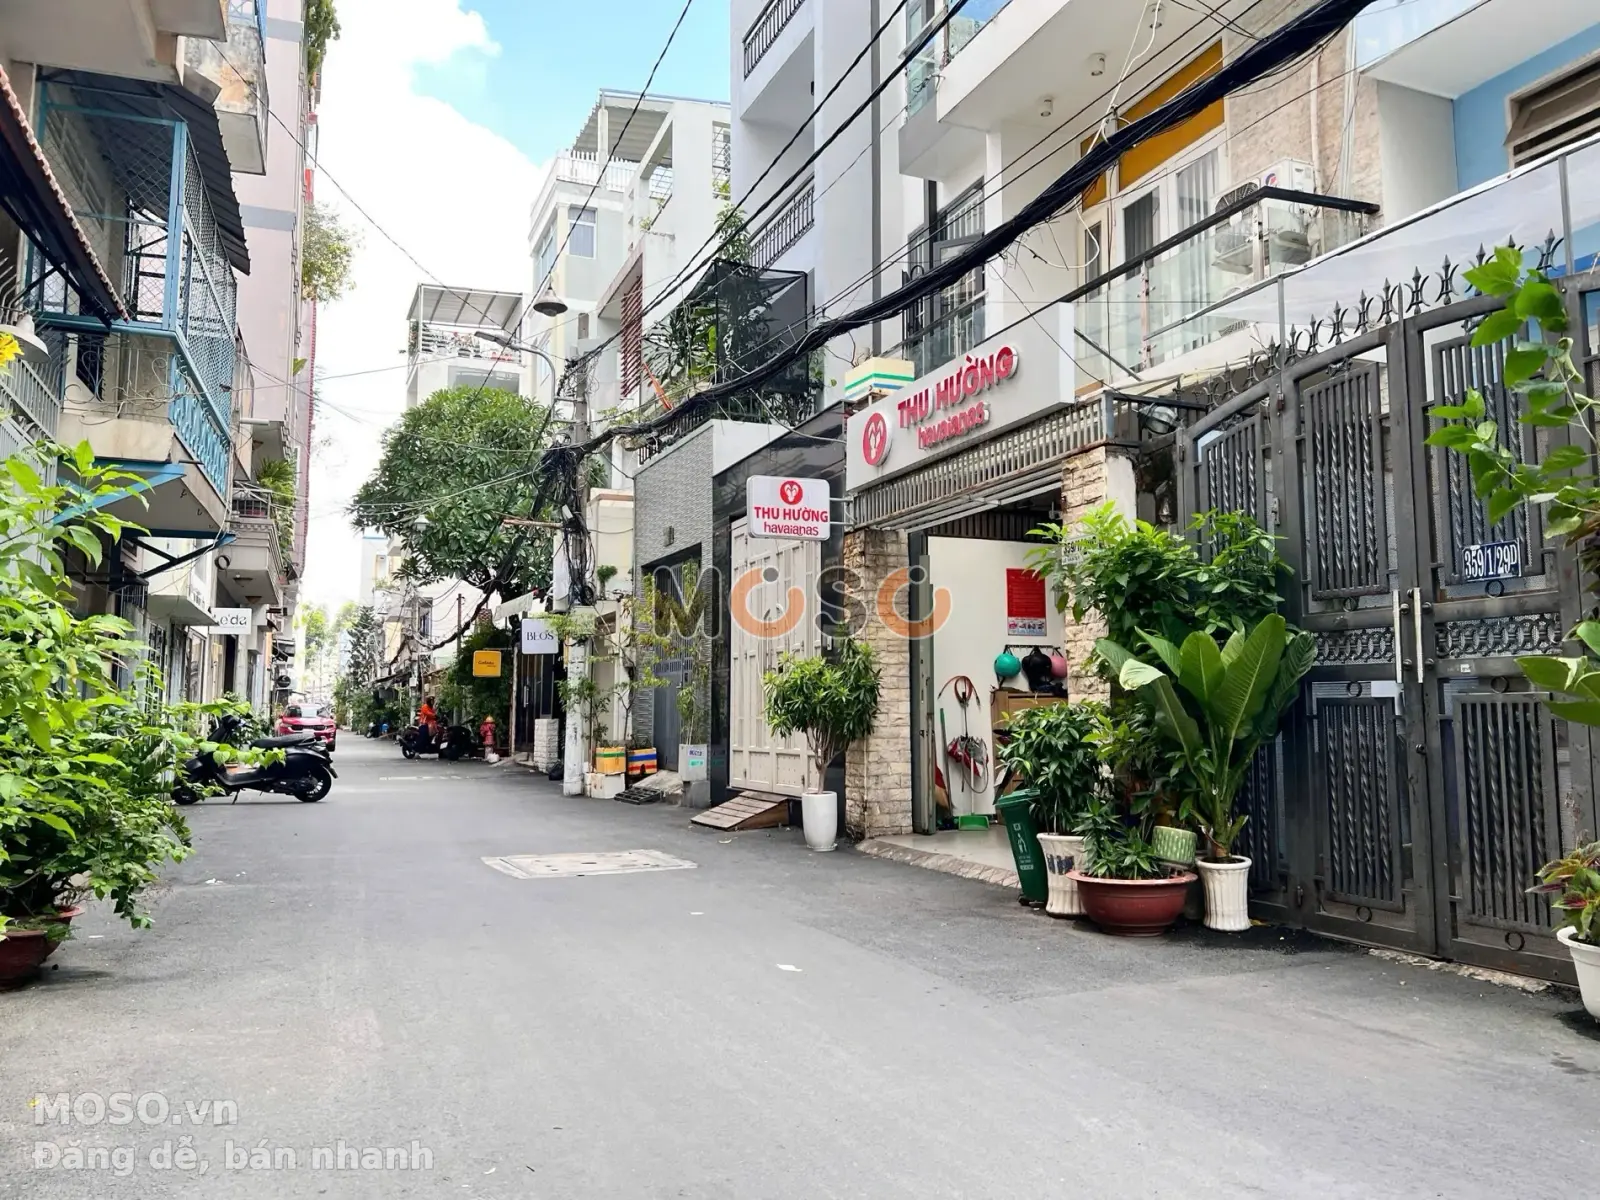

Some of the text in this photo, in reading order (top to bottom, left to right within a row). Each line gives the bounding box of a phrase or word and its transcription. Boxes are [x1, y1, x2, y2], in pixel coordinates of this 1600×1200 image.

[897, 345, 1018, 429] THU HƯỜNG
[917, 401, 986, 450] havaianas
[754, 506, 829, 522] THU HƯỜNG
[763, 521, 819, 536] havaianas
[1464, 544, 1518, 578] 359/1/29D
